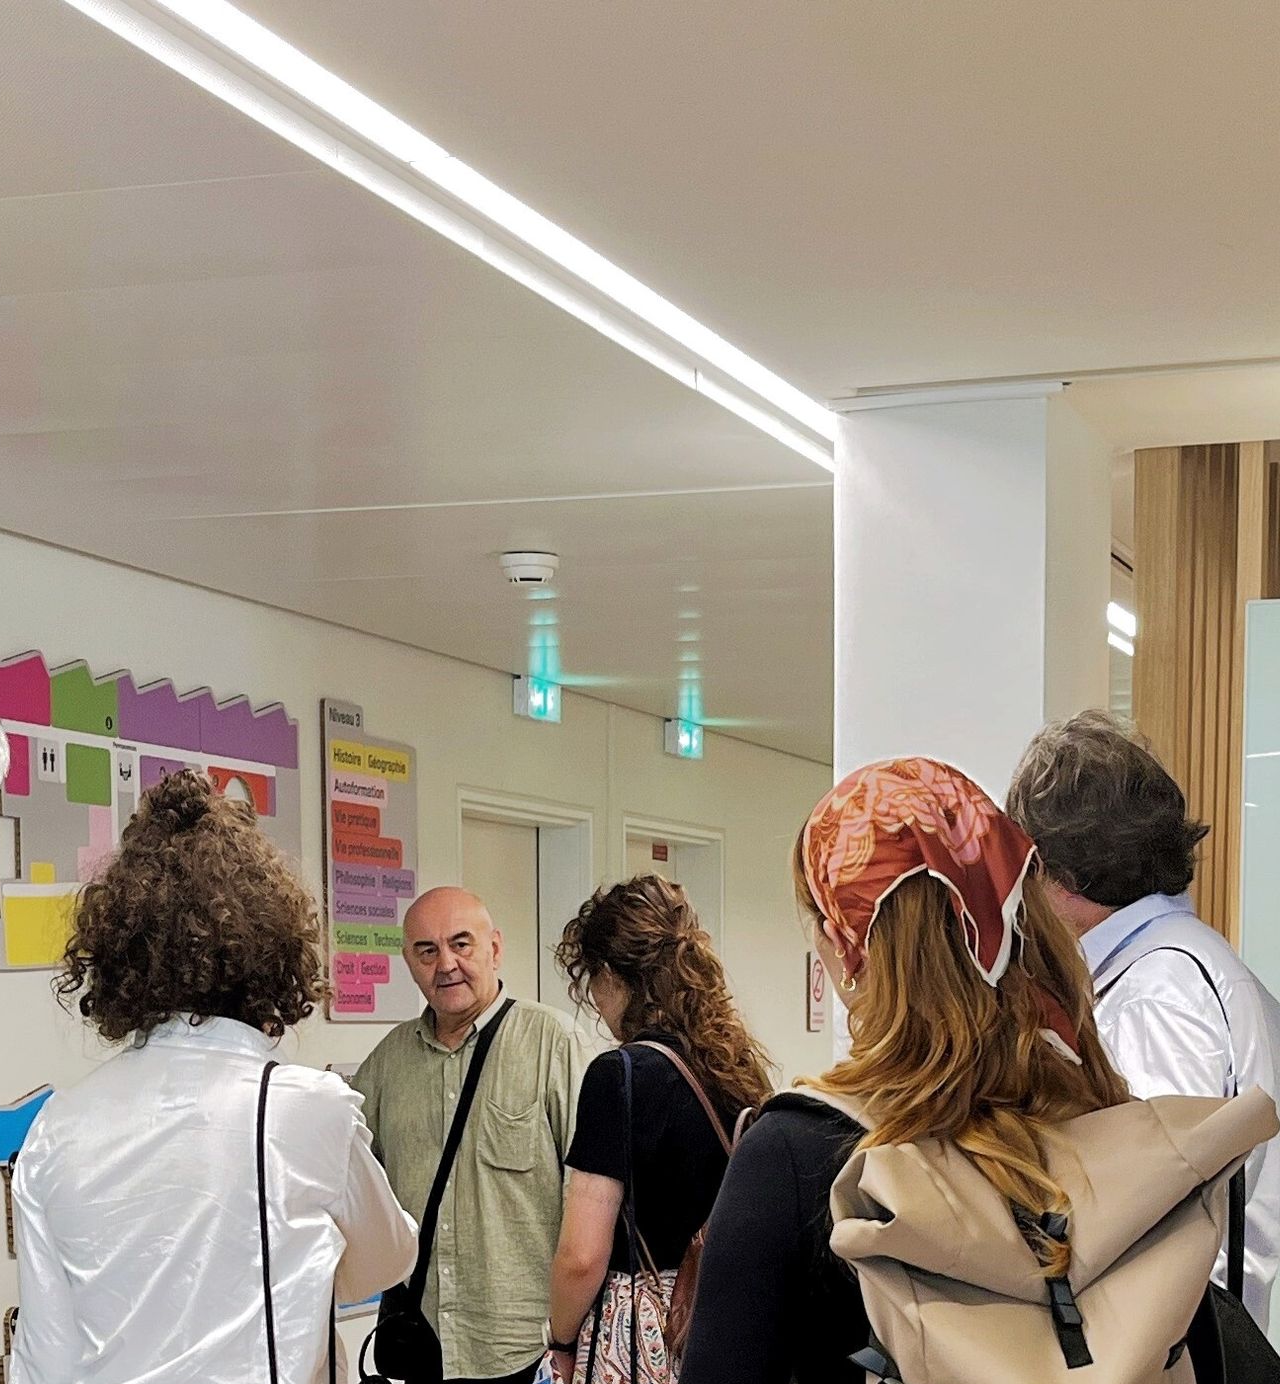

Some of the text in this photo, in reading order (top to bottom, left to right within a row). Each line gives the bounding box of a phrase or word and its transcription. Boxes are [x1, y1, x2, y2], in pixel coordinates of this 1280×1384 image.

[329, 707, 361, 727] Niveau 3
[333, 748, 407, 775] Histoire Géographie
[334, 779, 385, 800] Autoformation
[335, 809, 377, 831] Vie pratique
[335, 839, 400, 861] Vie professionnelle
[335, 870, 413, 893] Philosophie Religions
[336, 900, 395, 918] Sciences sociales
[336, 930, 368, 946] Sciences
[336, 960, 387, 976] Droit Gestion
